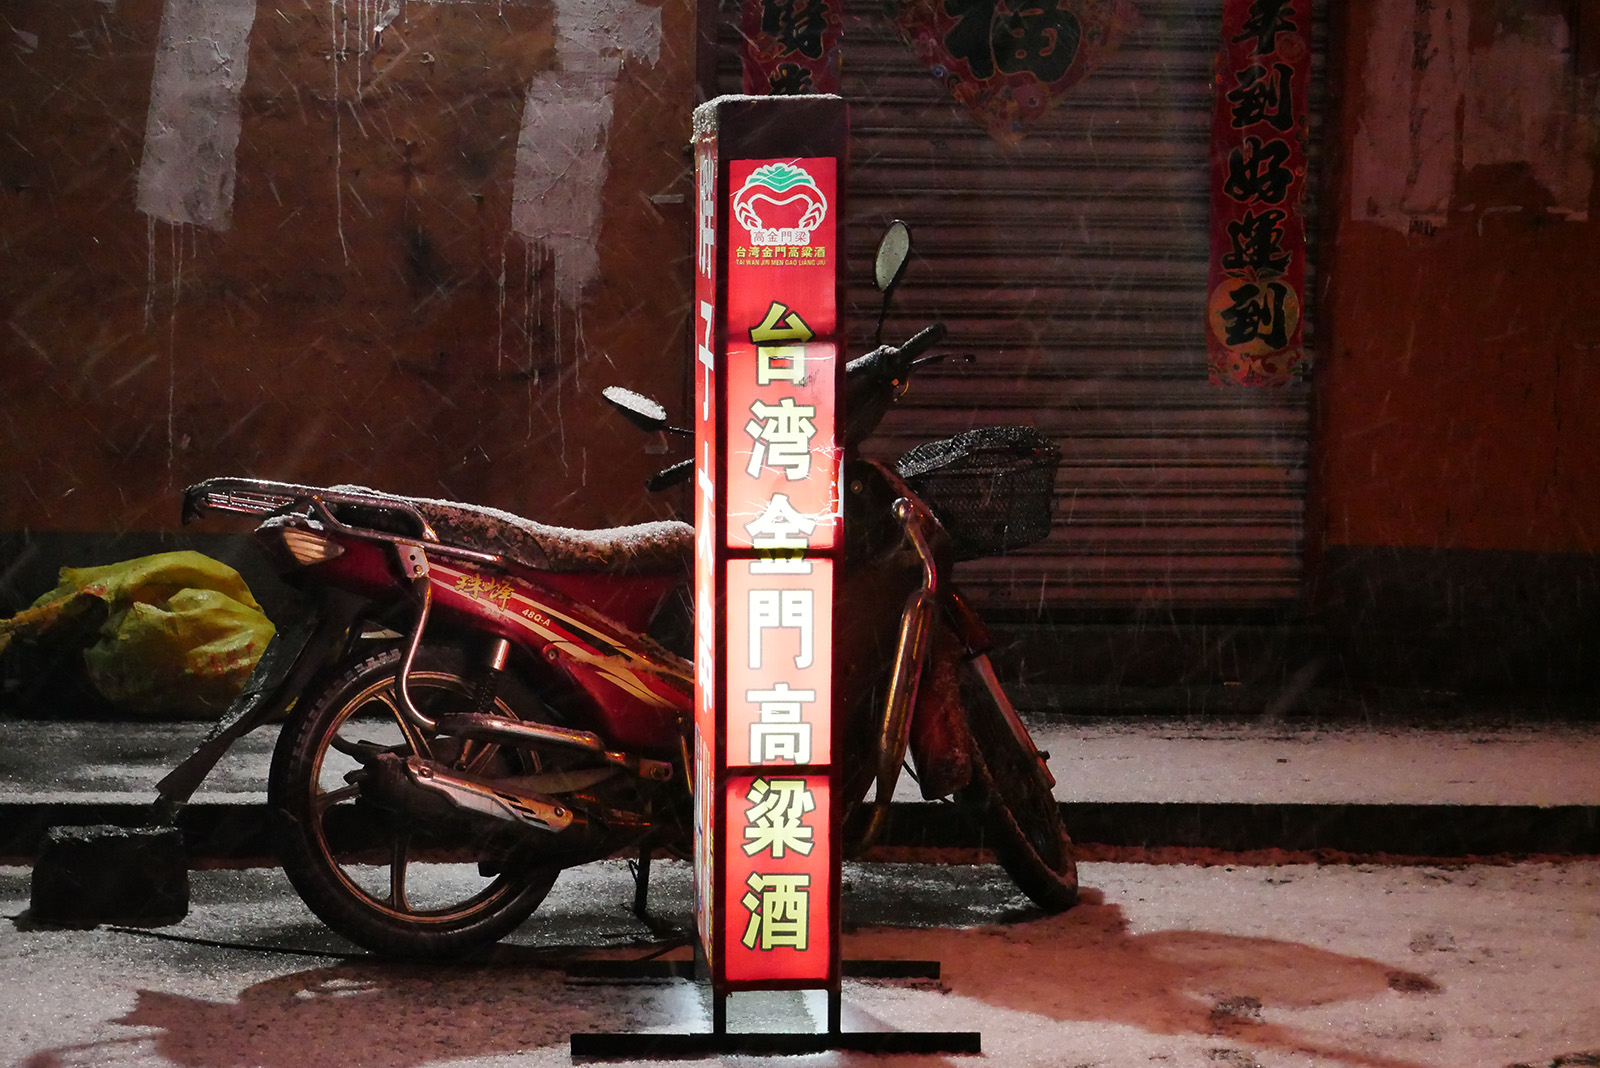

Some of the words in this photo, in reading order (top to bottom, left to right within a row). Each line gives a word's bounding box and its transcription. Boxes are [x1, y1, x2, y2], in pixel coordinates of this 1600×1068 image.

[454, 573, 514, 611] 珠峰
[522, 608, 551, 627] 48Q-A
[742, 301, 817, 951] 台湾金門高粱酒
